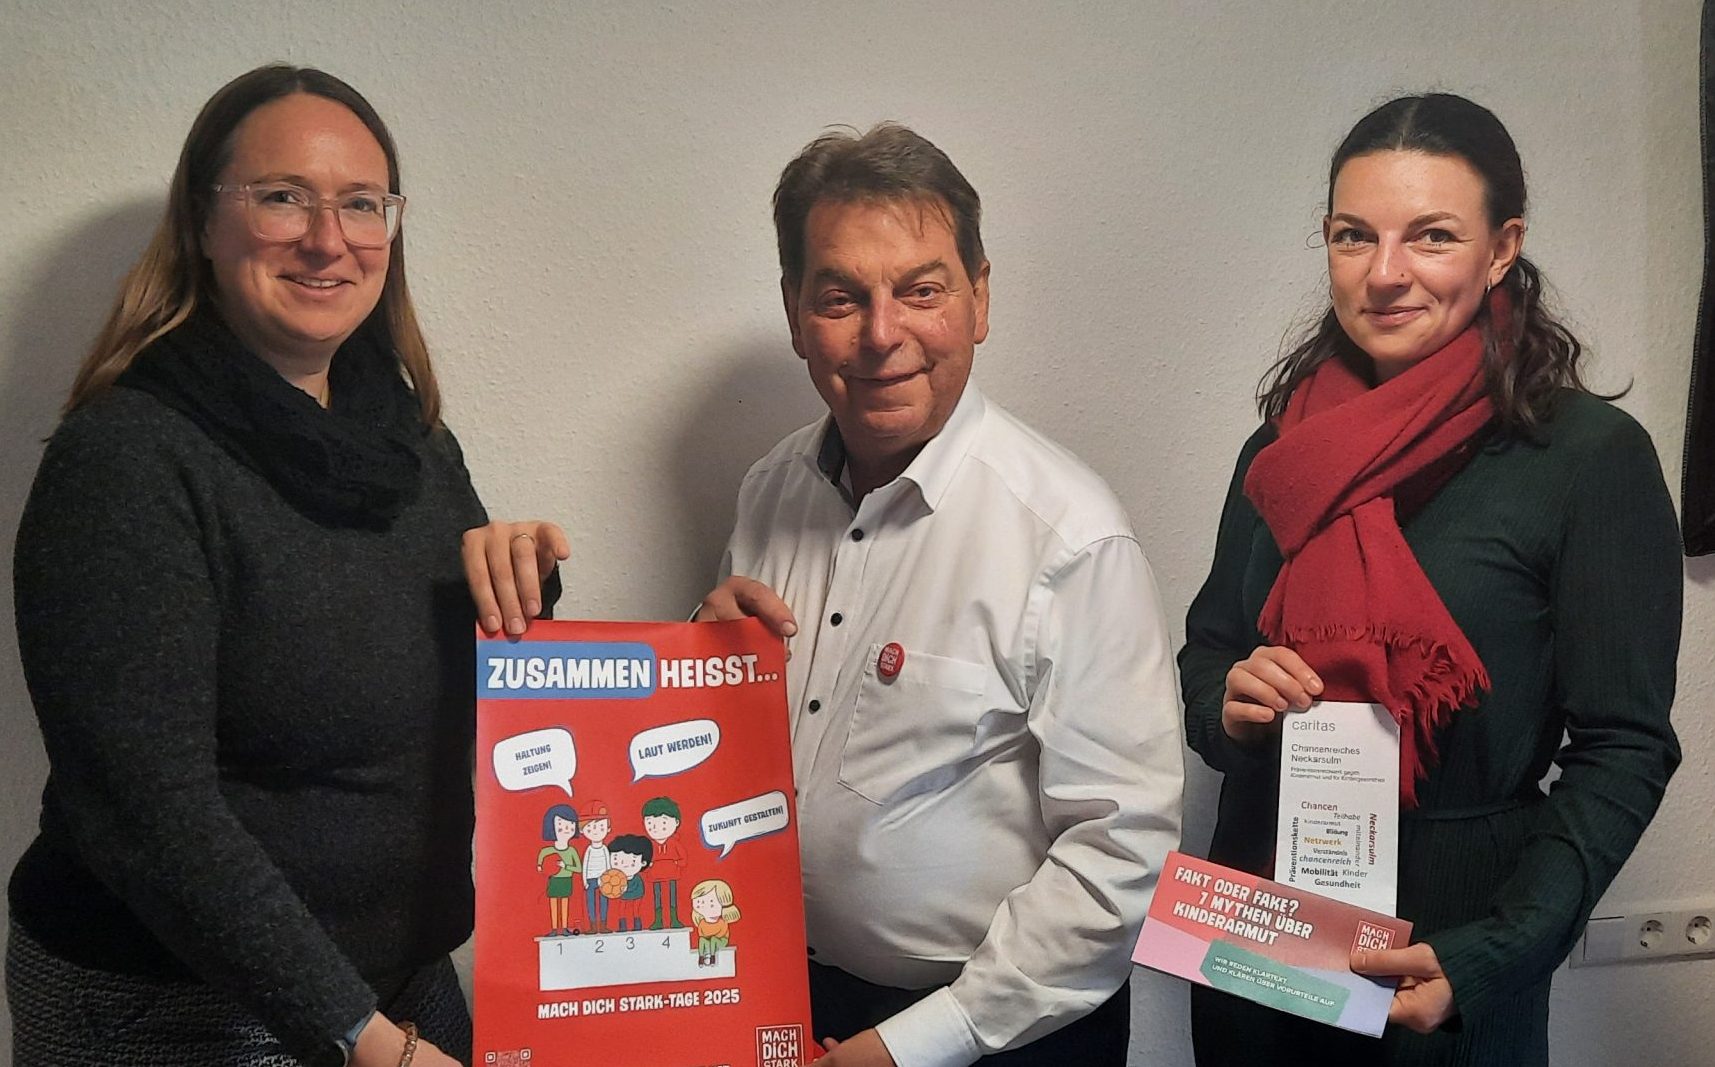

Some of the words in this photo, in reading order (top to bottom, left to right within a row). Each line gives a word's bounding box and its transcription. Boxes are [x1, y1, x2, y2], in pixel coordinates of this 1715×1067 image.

[487, 658, 650, 689] ZUSAMMEN
[660, 654, 778, 688] HEISST...
[1292, 720, 1336, 732] caritas
[515, 744, 551, 761] HALTUNG
[638, 744, 663, 759] LAUT
[667, 732, 712, 753] WERDEN!
[1291, 743, 1360, 755] Chancenreiches
[523, 760, 552, 775] ZEIGEN!
[1291, 754, 1342, 764] Neckarsulm
[1301, 801, 1338, 811] Chancen
[708, 817, 742, 832] ZUKUNFT
[744, 805, 784, 824] GESTALTEN!
[1333, 812, 1361, 820] Teilhabe
[1304, 836, 1342, 846] Netzwerk
[1368, 813, 1378, 865] Neckarsulm
[1288, 816, 1299, 882] Präventionskette
[1300, 854, 1351, 866] chancenreich
[1301, 867, 1338, 877] Mobilität
[1342, 868, 1368, 878] Kinder
[1174, 866, 1212, 888] FAKT
[1214, 878, 1250, 901] ODER
[1253, 890, 1299, 917] FAKE?
[1314, 878, 1361, 889] Gesundheit
[1172, 901, 1279, 945] KINDERARMUT
[1198, 891, 1209, 905] 7
[1210, 895, 1272, 926] MYTHEN
[1275, 913, 1313, 939] ÜBER
[1361, 924, 1390, 940] MACH
[557, 943, 563, 955] 1
[595, 940, 604, 953] 2
[626, 937, 635, 950] 3
[662, 936, 670, 949] 4
[1214, 956, 1228, 966] WIR
[1229, 960, 1251, 973] REDEN
[1252, 967, 1287, 984] KLARTEXT
[1212, 964, 1227, 973] UND
[1228, 969, 1255, 983] KLÄREN
[1256, 977, 1275, 989] ÜBER
[1276, 984, 1319, 1002] VORURTEILE
[1319, 998, 1335, 1007] AUF
[537, 1001, 578, 1019] MACH
[582, 999, 615, 1016] DICH
[619, 991, 700, 1012] STARK-TAGE
[704, 989, 740, 1005] 2025
[762, 1029, 797, 1043] MACH
